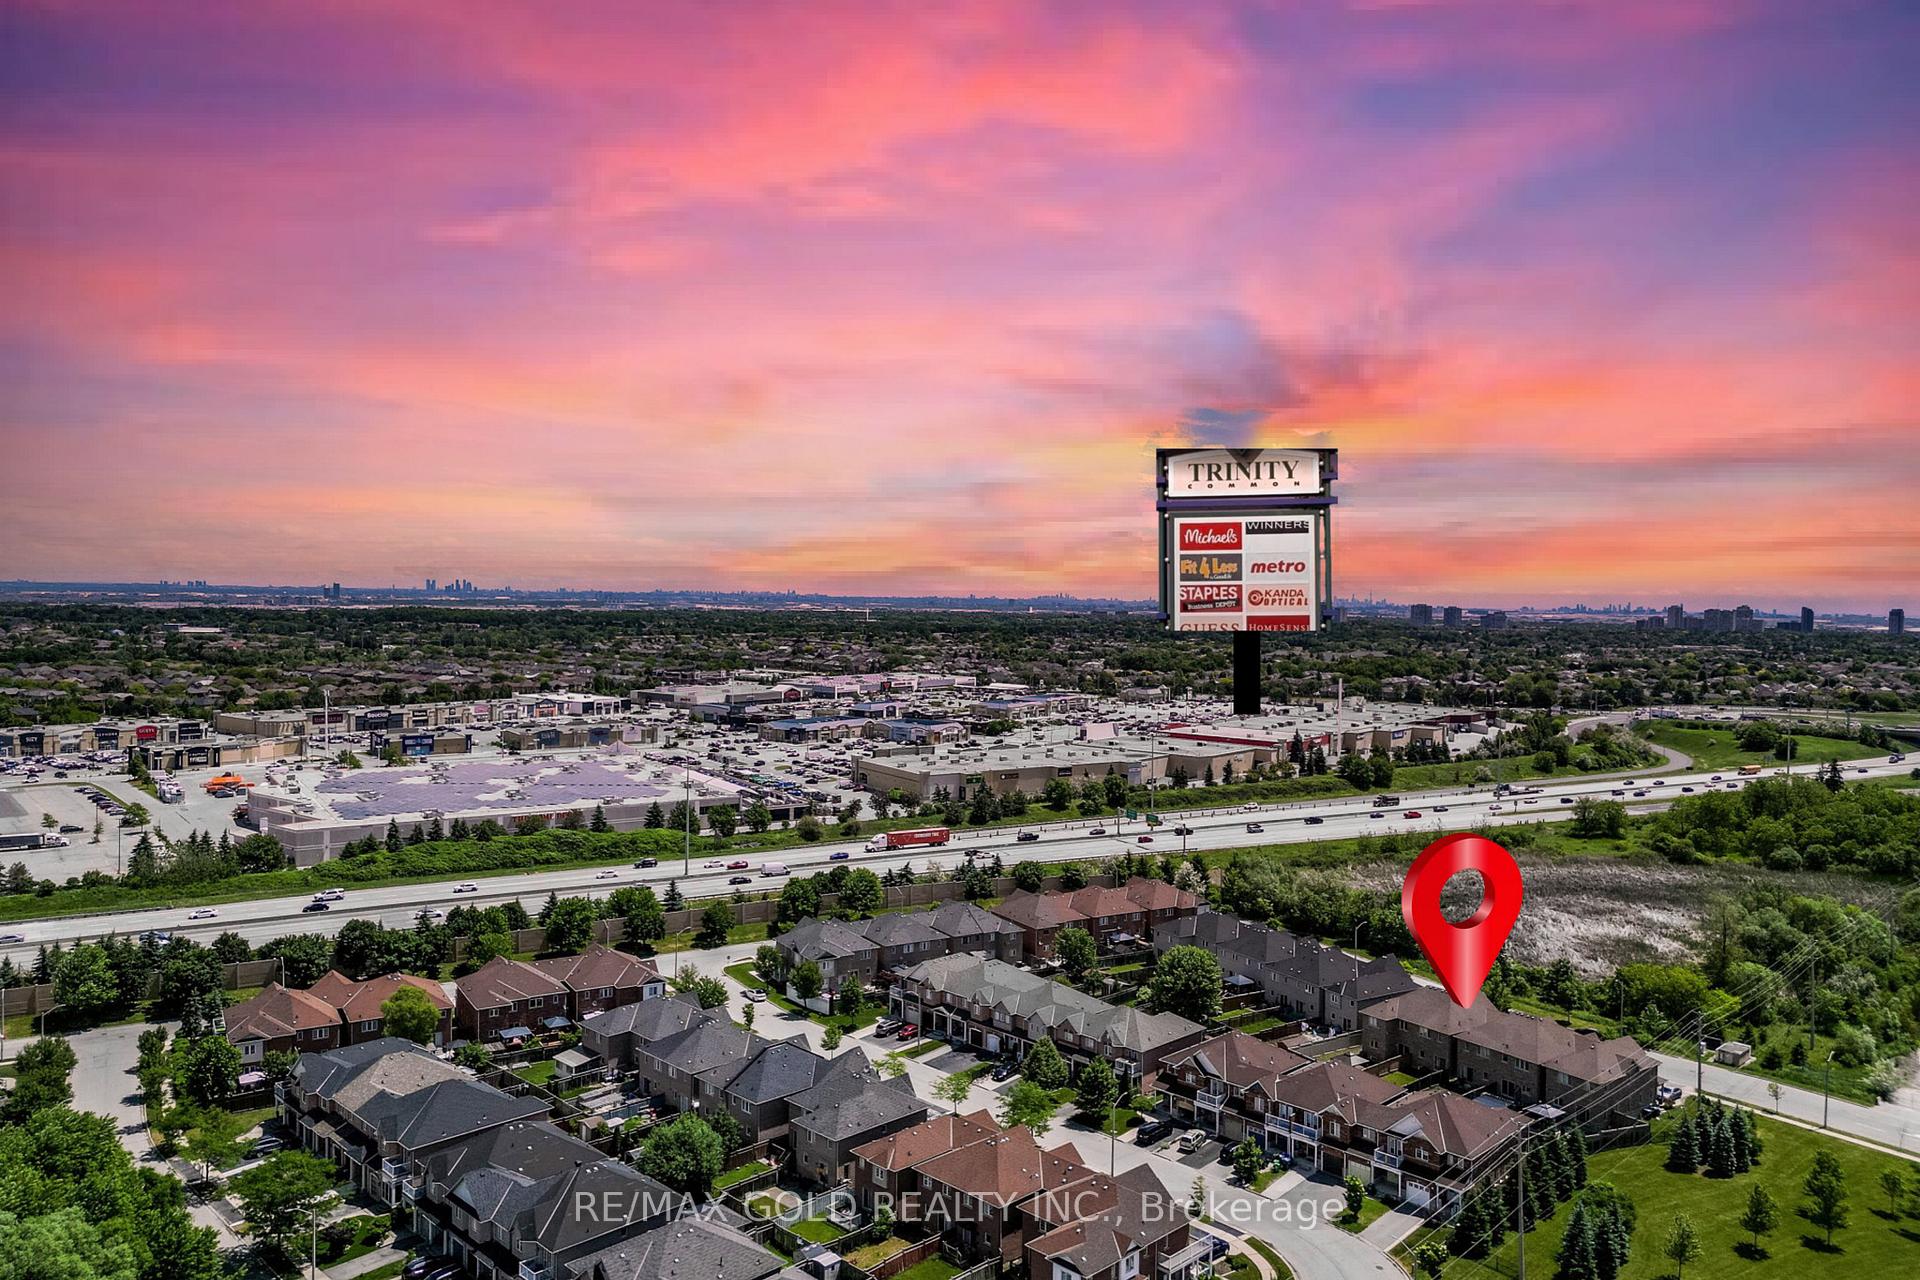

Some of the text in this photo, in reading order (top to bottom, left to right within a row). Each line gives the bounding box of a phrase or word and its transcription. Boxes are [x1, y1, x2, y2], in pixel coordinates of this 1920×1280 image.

[1188, 460, 1299, 482] TRINITY
[1188, 481, 1300, 489] COMMON
[1247, 520, 1309, 530] WINNERS
[1184, 528, 1238, 544] Michaels
[1180, 559, 1197, 574] Fit
[1199, 556, 1210, 579] 4
[1250, 560, 1306, 574] metro
[1180, 586, 1238, 600] STAPLES
[1263, 597, 1308, 606] OPTICAL
